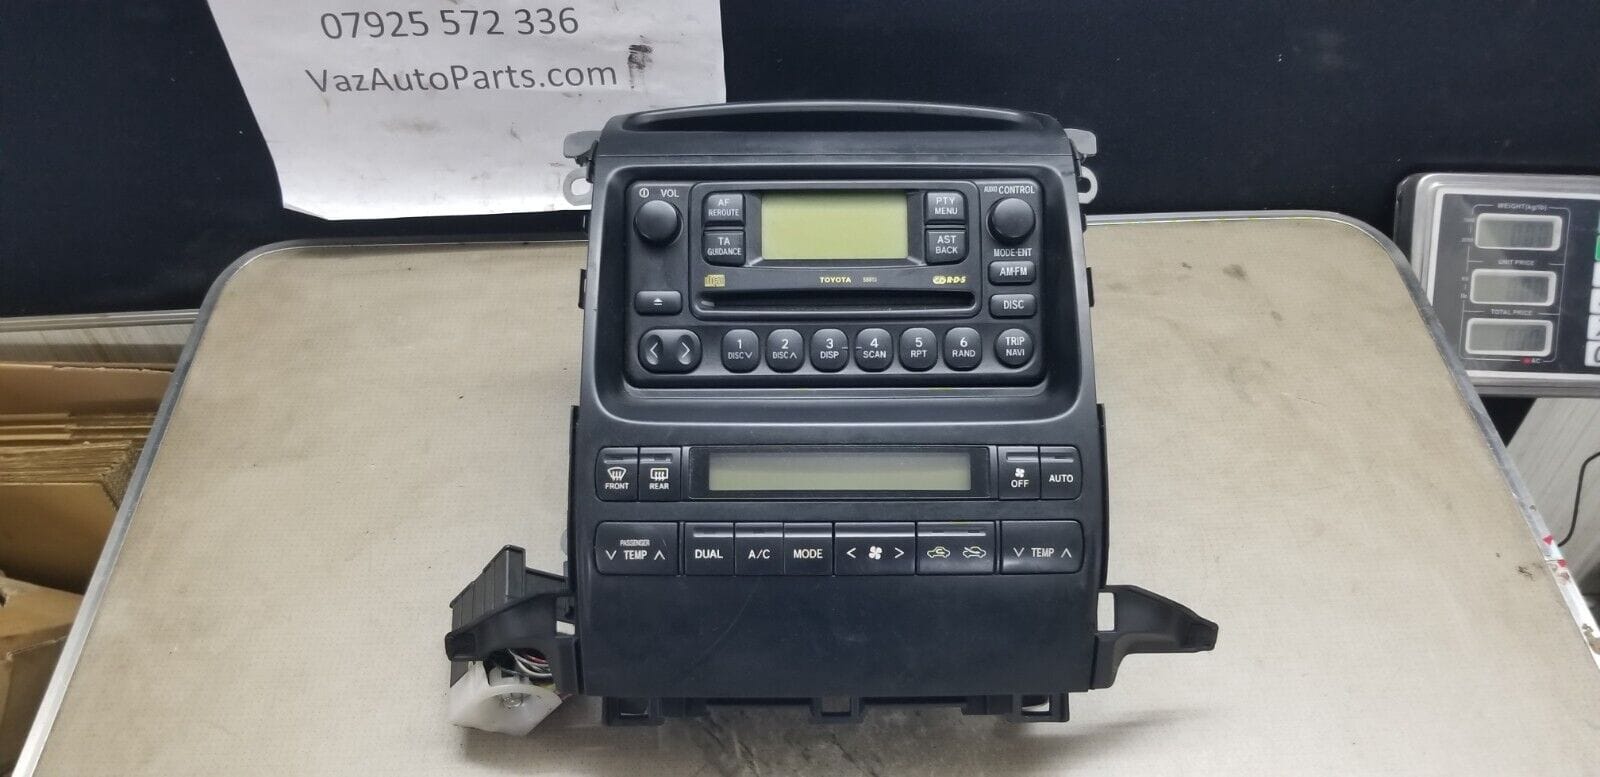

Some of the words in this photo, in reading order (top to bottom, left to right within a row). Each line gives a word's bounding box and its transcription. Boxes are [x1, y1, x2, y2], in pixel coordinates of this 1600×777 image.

[320, 11, 430, 39] 07925
[439, 9, 505, 36] 572
[514, 6, 579, 35] 336
[304, 64, 618, 93] VazAutoParts.com
[660, 188, 680, 198] VOL
[998, 185, 1036, 195] CONTROL
[717, 198, 730, 207] AF
[936, 196, 955, 205] PTY
[707, 208, 740, 217] REROUTE
[934, 206, 958, 216] MENU
[717, 237, 731, 246] TA
[936, 235, 956, 244] AST
[706, 247, 742, 256] GUIDANCE
[935, 246, 958, 255] BACK
[1514, 259, 1535, 267] PRICE
[1003, 299, 1025, 310] DISC
[1491, 308, 1512, 316] TOTAL
[1513, 309, 1534, 317] PRICE
[737, 339, 743, 349] 1
[781, 338, 789, 350] 2
[825, 338, 834, 348] 3
[870, 338, 879, 348] 4
[915, 337, 923, 348] 5
[959, 337, 968, 348] 6
[1005, 336, 1025, 347] TRIP
[727, 351, 744, 360] DISC
[772, 351, 788, 360] DISC
[820, 350, 840, 359] DISP
[862, 350, 887, 359] SCAN
[910, 349, 928, 358] RPT
[952, 349, 976, 358] RAND
[1005, 348, 1025, 357] NAVI
[1048, 474, 1074, 483] AUTO
[604, 482, 630, 490] FRONT
[649, 482, 670, 490] REAR
[1010, 479, 1029, 488] OFF
[623, 550, 648, 560] TEMP
[694, 549, 724, 559] DUAL
[748, 549, 770, 560] A/C
[793, 549, 824, 559] MODE
[1031, 547, 1055, 558] TEMP
